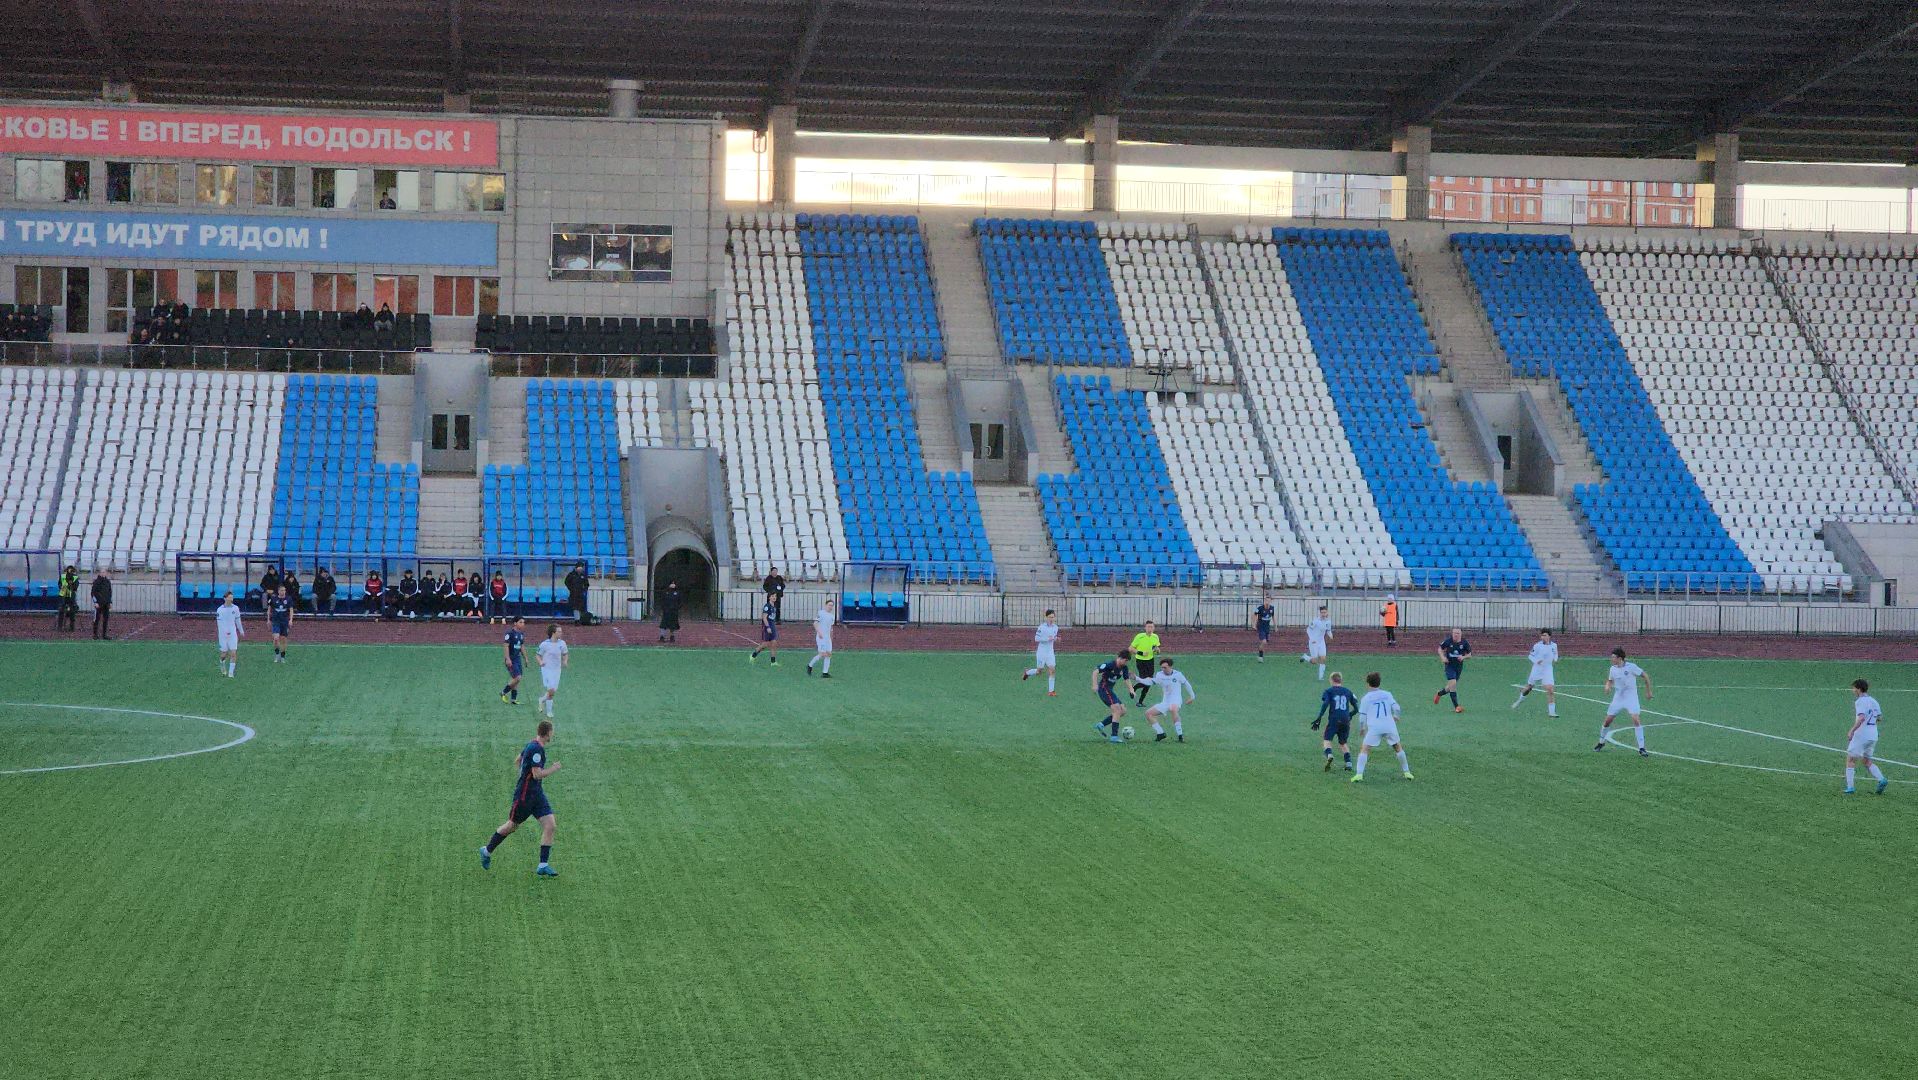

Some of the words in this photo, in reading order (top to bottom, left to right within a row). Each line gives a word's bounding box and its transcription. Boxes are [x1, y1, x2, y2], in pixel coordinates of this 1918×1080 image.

[0, 116, 109, 141] КОВЬЕ
[119, 120, 128, 141] !
[138, 121, 271, 150] ВПЕРЕД,
[281, 125, 454, 151] ПОДОЛЬСК
[463, 131, 471, 152] !
[15, 220, 97, 247] ТРУД
[106, 222, 190, 248] ИДУТ
[199, 224, 309, 250] РЯДОМ
[319, 228, 328, 249] !
[1374, 701, 1387, 718] 71
